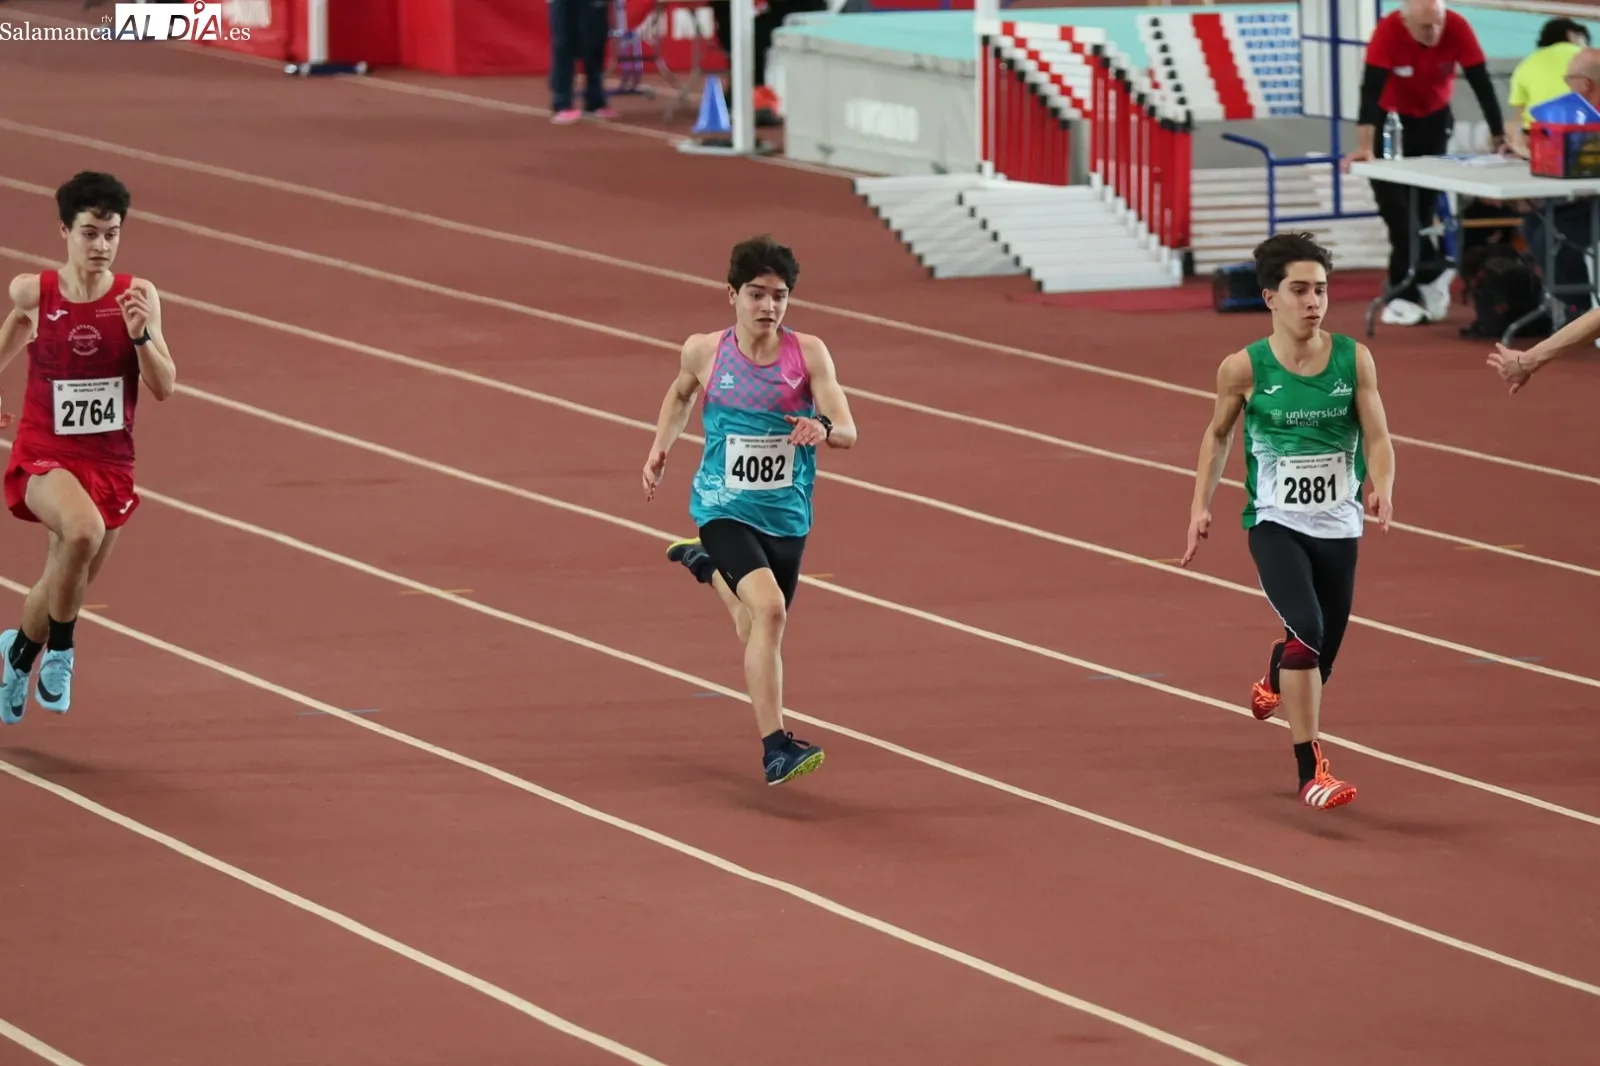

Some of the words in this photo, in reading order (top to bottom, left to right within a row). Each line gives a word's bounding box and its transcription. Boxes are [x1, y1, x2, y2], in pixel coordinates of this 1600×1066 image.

[61, 397, 116, 427] 2764
[1285, 406, 1348, 419] universidad
[731, 454, 786, 483] 4082
[1284, 474, 1336, 505] 2881
